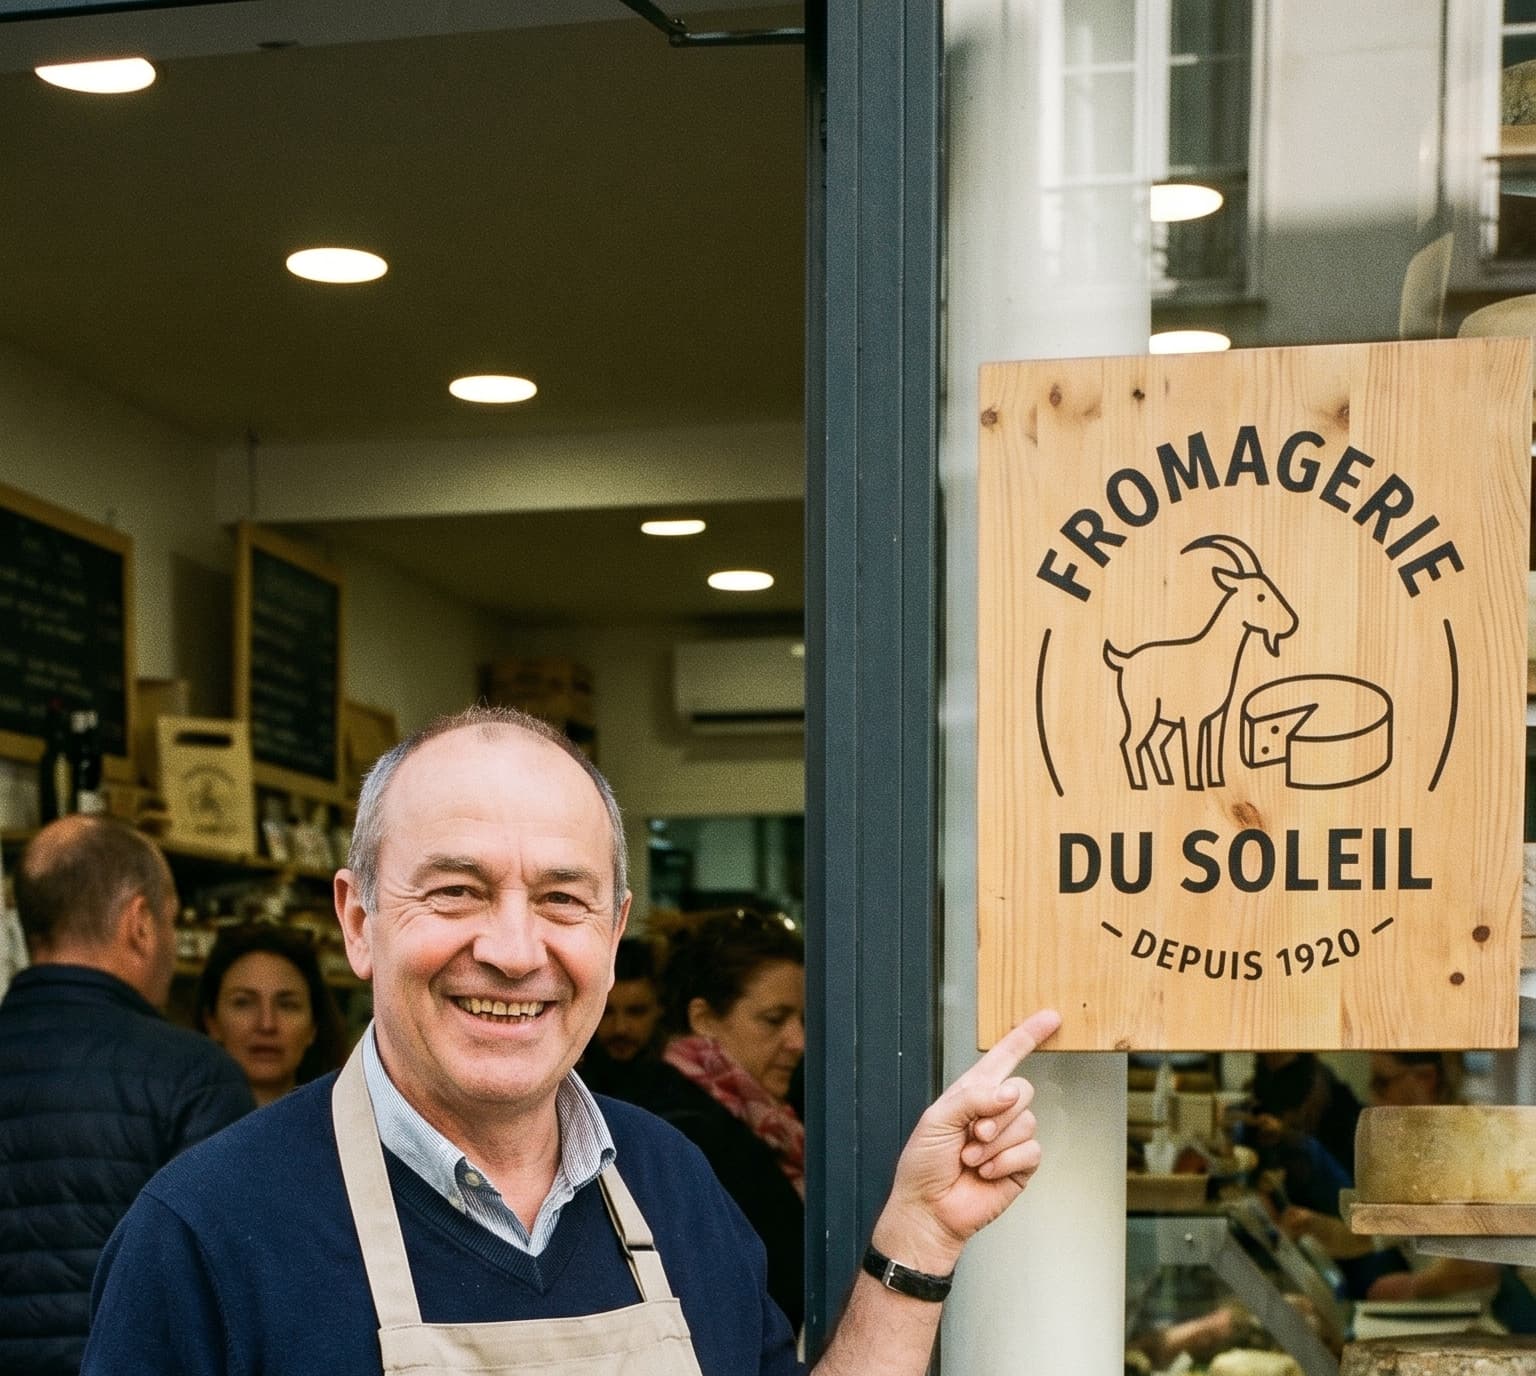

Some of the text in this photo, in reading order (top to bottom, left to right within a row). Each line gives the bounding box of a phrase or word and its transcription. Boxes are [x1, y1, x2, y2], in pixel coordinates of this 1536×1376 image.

[1036, 425, 1465, 602] FROMAGERIE
[1059, 828, 1433, 895] DU SOLEIL
[1130, 928, 1361, 981] DEPUIS 1920
